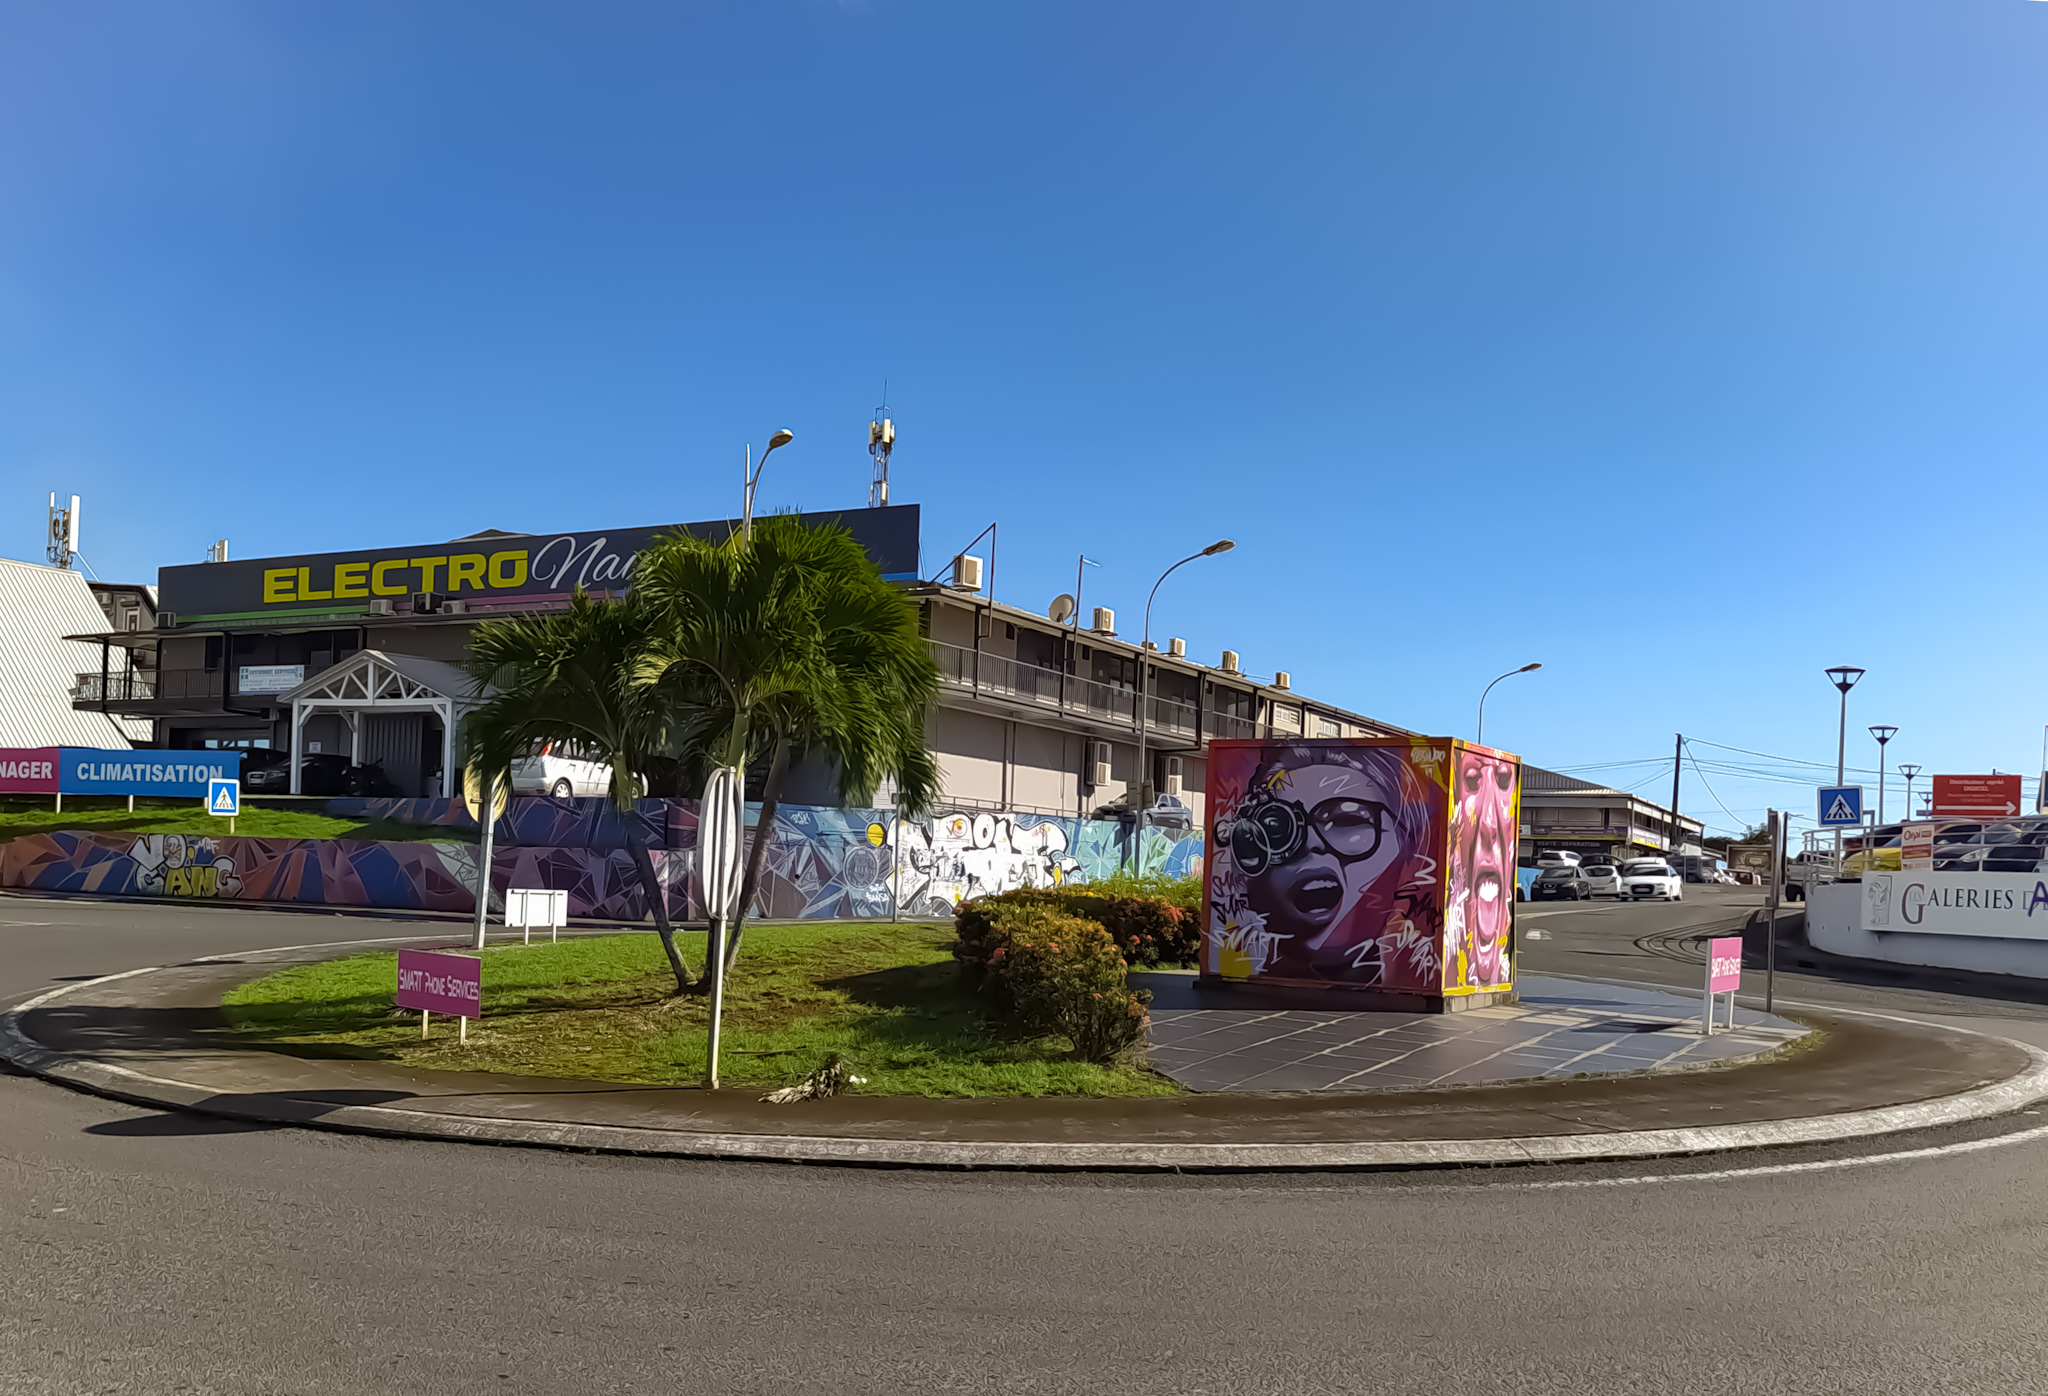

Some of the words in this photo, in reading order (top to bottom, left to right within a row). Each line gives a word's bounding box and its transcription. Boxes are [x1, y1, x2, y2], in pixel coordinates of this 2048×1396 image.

[264, 550, 529, 604] ELECTRO
[77, 763, 223, 783] CLIMATISATION
[1902, 883, 2014, 925] GALERIES
[399, 969, 423, 992] SMART
[424, 972, 446, 996] PHONE
[447, 975, 478, 1000] SERVICES
